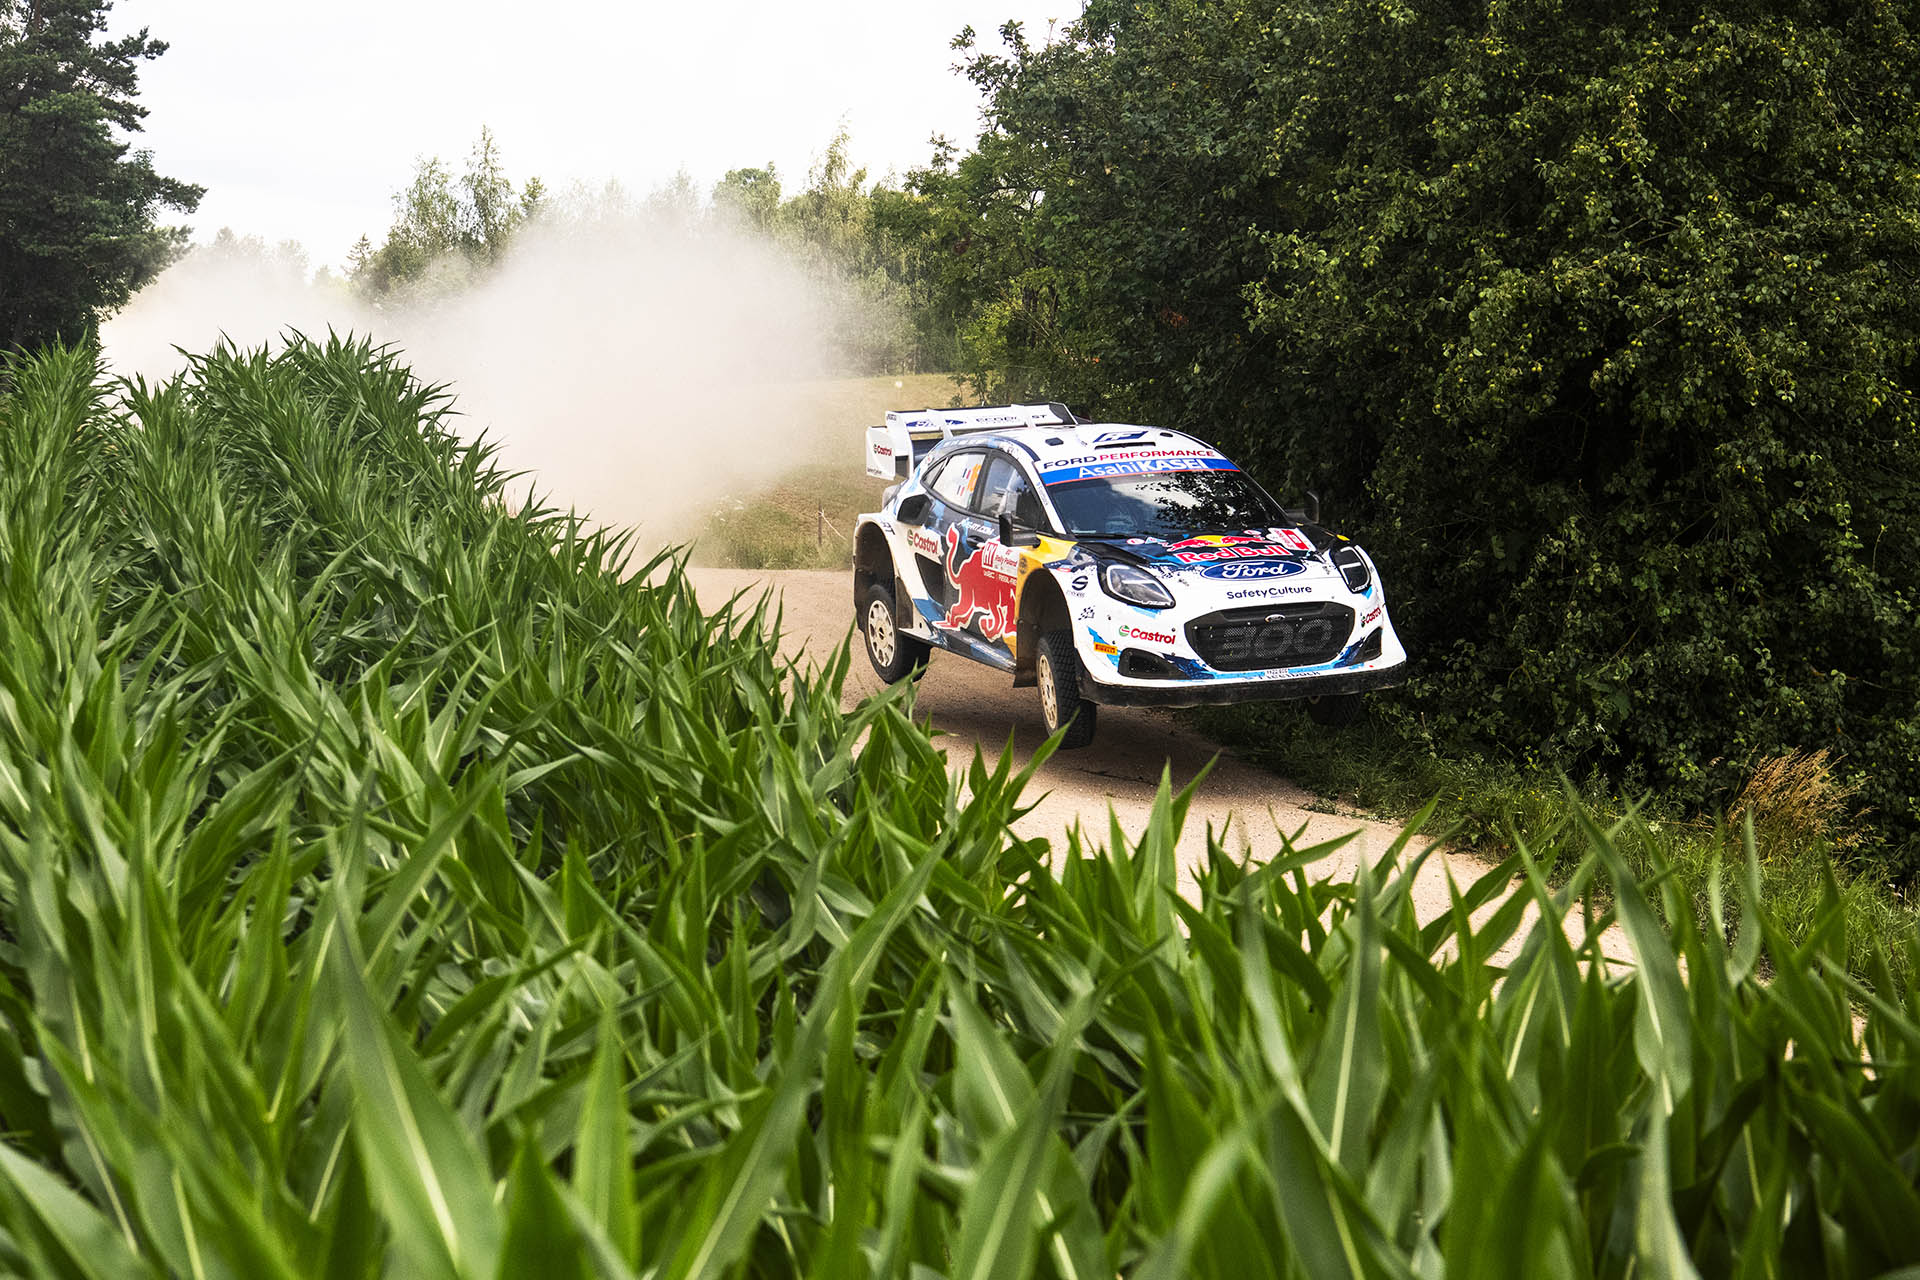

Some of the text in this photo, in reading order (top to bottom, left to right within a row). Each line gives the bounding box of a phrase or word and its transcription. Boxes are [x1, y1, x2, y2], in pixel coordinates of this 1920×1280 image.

[877, 444, 893, 456] Castrol
[1043, 449, 1215, 470] FORD PERFORMANCE
[1078, 457, 1208, 479] AsahiKASEI
[913, 532, 938, 554] Castrol
[1174, 544, 1293, 564] Red Bull
[1222, 562, 1288, 579] Ford
[1226, 585, 1312, 600] SafetyCulture
[1131, 628, 1176, 645] Castrol
